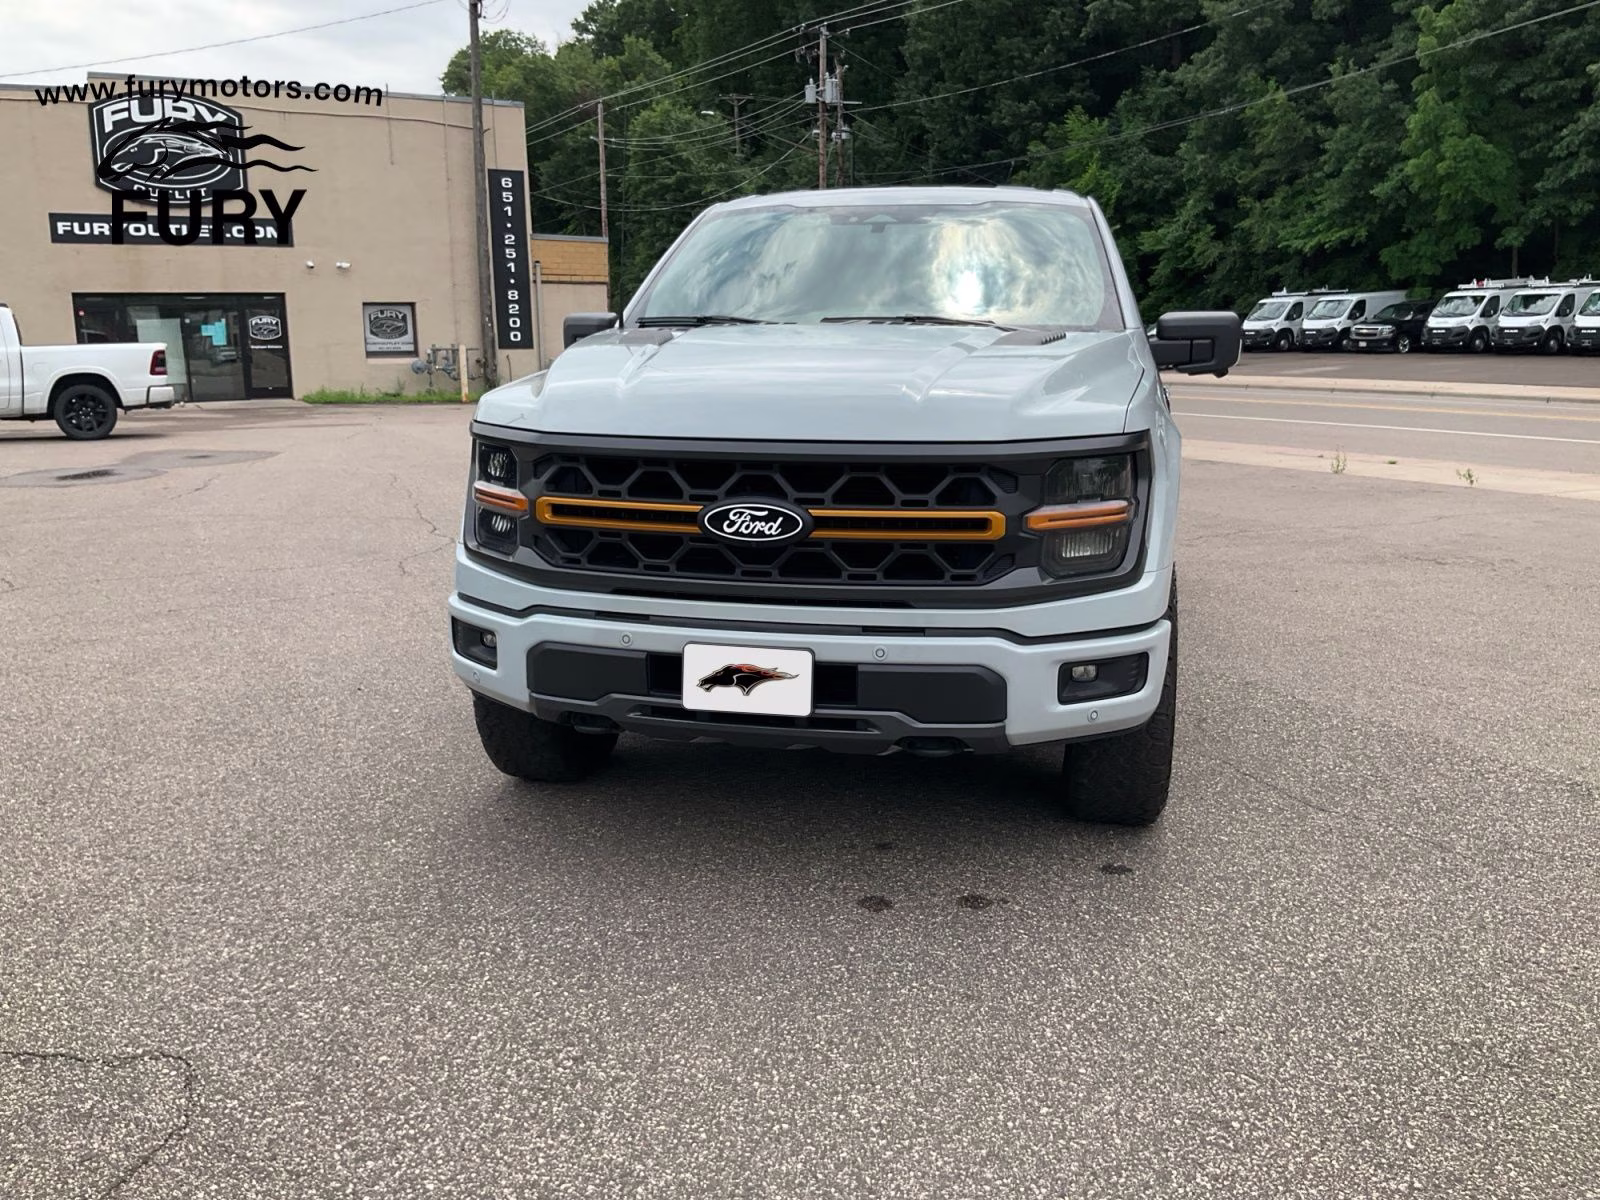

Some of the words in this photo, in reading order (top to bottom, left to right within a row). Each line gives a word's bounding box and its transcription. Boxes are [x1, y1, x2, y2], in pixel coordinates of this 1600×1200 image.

[103, 98, 228, 134] FURY
[370, 309, 404, 321] FURY
[722, 508, 784, 536] Ford
